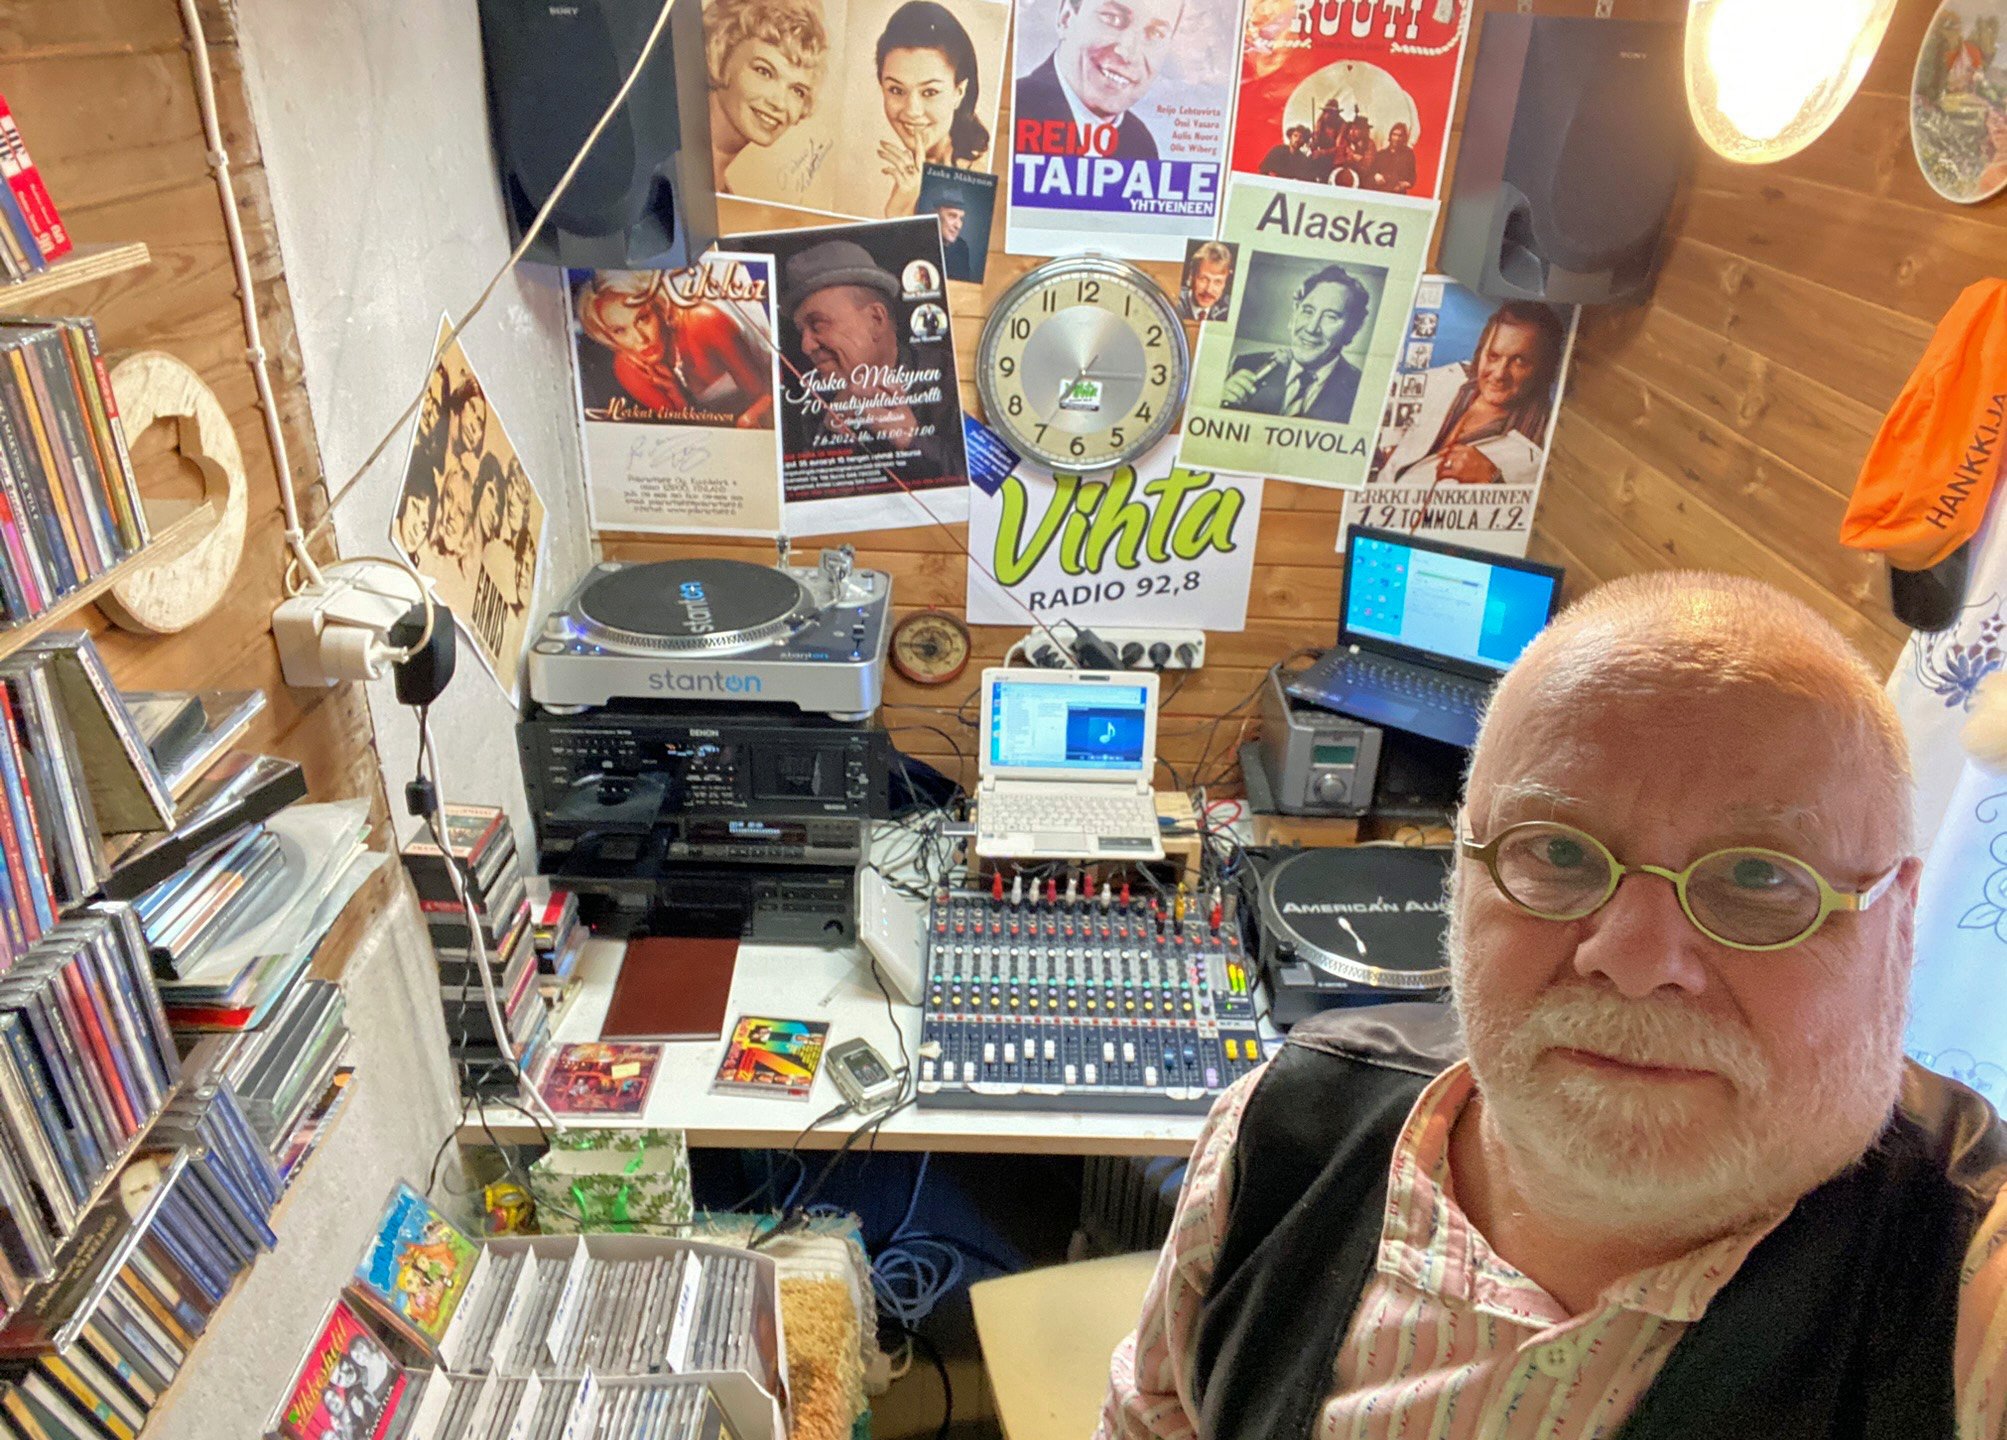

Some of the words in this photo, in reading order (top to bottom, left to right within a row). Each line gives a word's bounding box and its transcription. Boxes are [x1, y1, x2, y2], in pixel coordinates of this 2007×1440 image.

[1015, 118, 1119, 157] REIJO
[1014, 153, 1218, 202] TAIPALE
[1128, 198, 1214, 215] YHTYEINEEN
[1255, 192, 1399, 249] Alaska
[1042, 289, 1056, 313] 11
[1077, 281, 1100, 303] 12
[1124, 293, 1131, 317] 1
[1010, 317, 1031, 340] 10
[1146, 325, 1163, 347] 2
[999, 356, 1015, 378] 9
[1150, 364, 1167, 386] 3
[785, 368, 847, 404] Jaska
[851, 363, 942, 396] Mäkynen
[1008, 395, 1023, 416] 8
[1135, 402, 1152, 423] 4
[1034, 423, 1049, 444] 7
[1110, 428, 1125, 448] 5
[1188, 417, 1251, 443] ONNI
[1264, 426, 1367, 457] TOIVOLA
[1069, 436, 1085, 456] 6
[1925, 393, 2007, 530] HANKKIJA
[1352, 489, 1409, 504] ERKKI
[1411, 489, 1535, 505] JUNKKARINEN
[993, 460, 1245, 588] Vihta
[1401, 508, 1479, 531] TOMMOLA
[1028, 580, 1125, 612] RADIO
[1135, 571, 1201, 599] 92,8
[648, 668, 763, 693] stanton
[689, 728, 720, 738] DENON
[1282, 901, 1400, 915] AMERICAN
